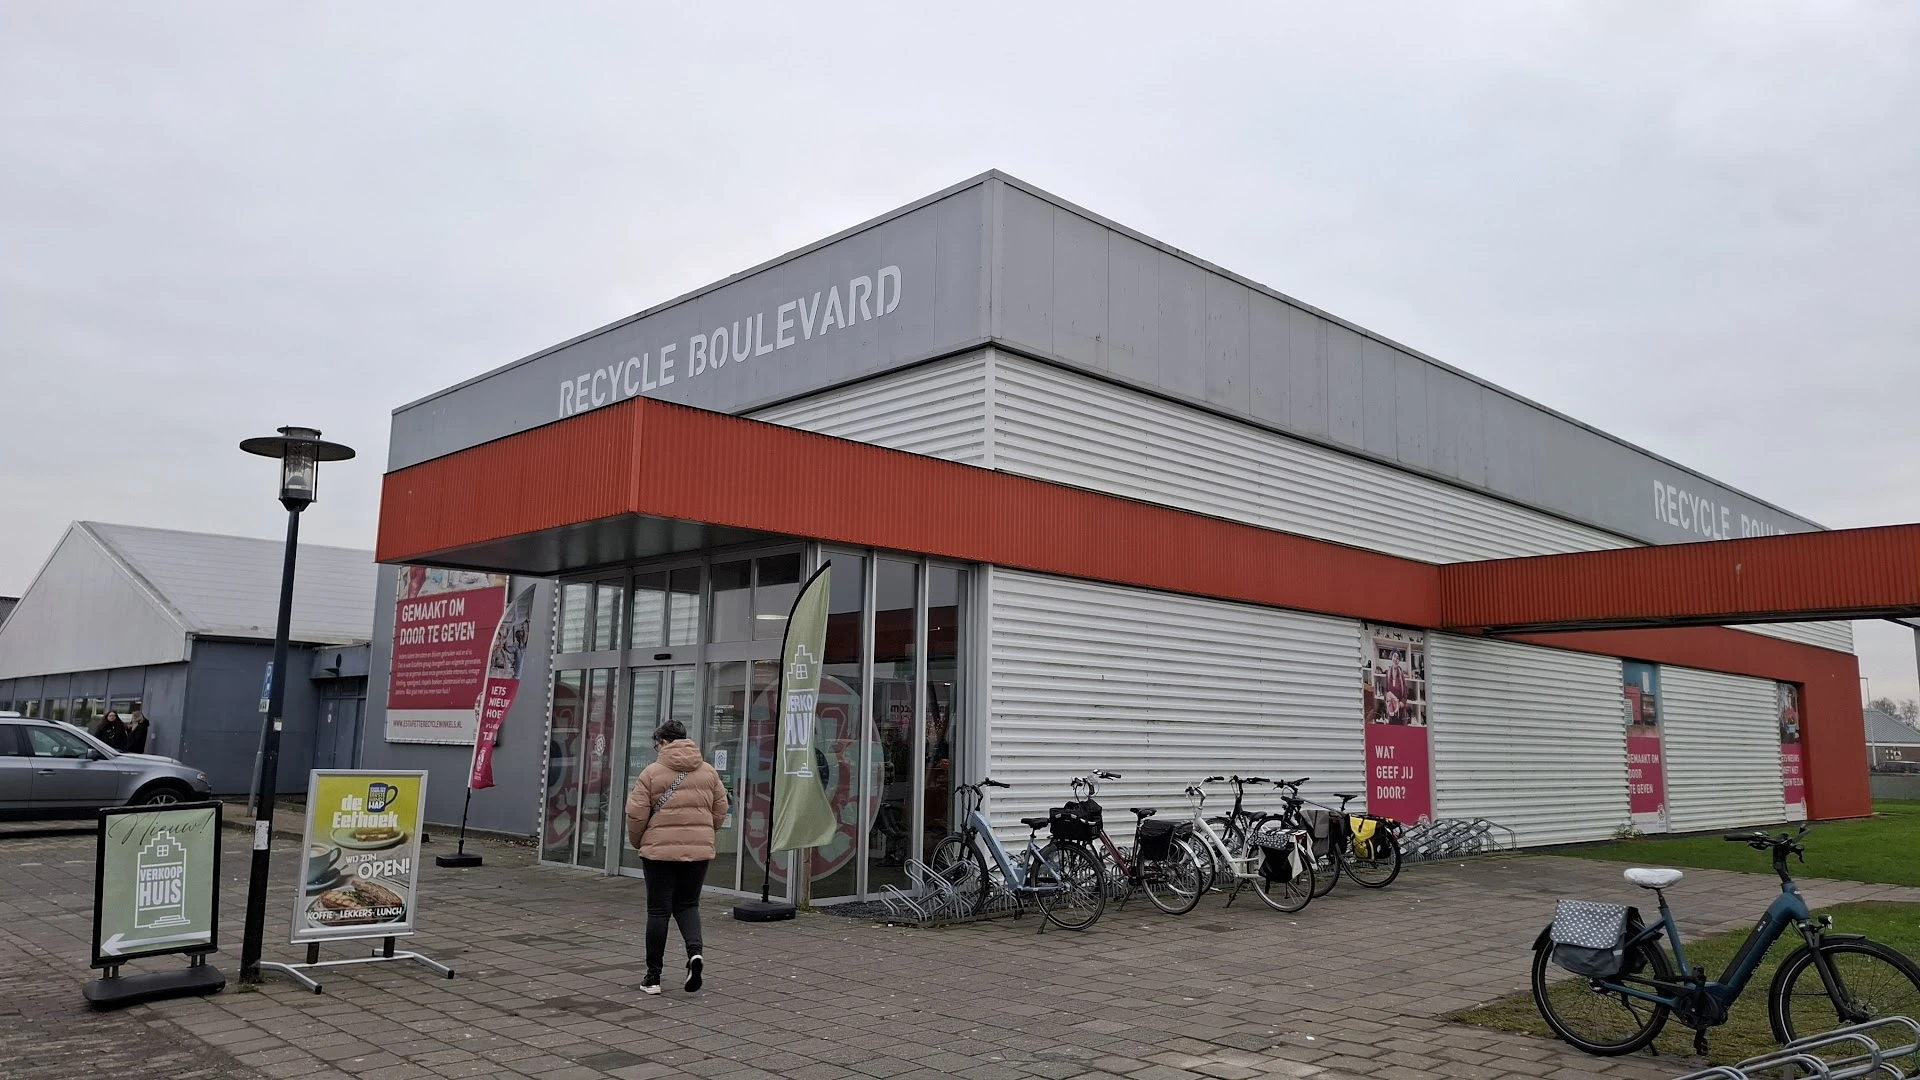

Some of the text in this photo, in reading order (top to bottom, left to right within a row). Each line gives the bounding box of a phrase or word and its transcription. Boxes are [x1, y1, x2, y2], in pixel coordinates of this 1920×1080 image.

[559, 265, 902, 418] RECYCLE BOULEVARD
[1653, 480, 1731, 540] RECYCLE
[402, 597, 464, 622] GEMAAKT OM
[400, 621, 475, 645] DOOR TE GEVEN
[491, 686, 507, 696] IETS
[1375, 745, 1395, 759] WAT
[1651, 753, 1660, 764] OM
[1376, 766, 1414, 779] GEEF JIJ
[1377, 786, 1406, 799] DOOR?
[1629, 783, 1654, 795] TE GEVEN
[341, 794, 362, 811] de
[368, 801, 385, 810] HAP
[332, 811, 398, 828] Eethoek
[108, 811, 215, 845] Nieuw!
[346, 853, 377, 864] WIJ ZIJN
[140, 866, 183, 881] VERKOOP
[358, 858, 410, 879] OPEN!
[139, 879, 182, 906] HUIS
[307, 910, 333, 920] KOFFIE
[377, 907, 402, 916] LUNCH
